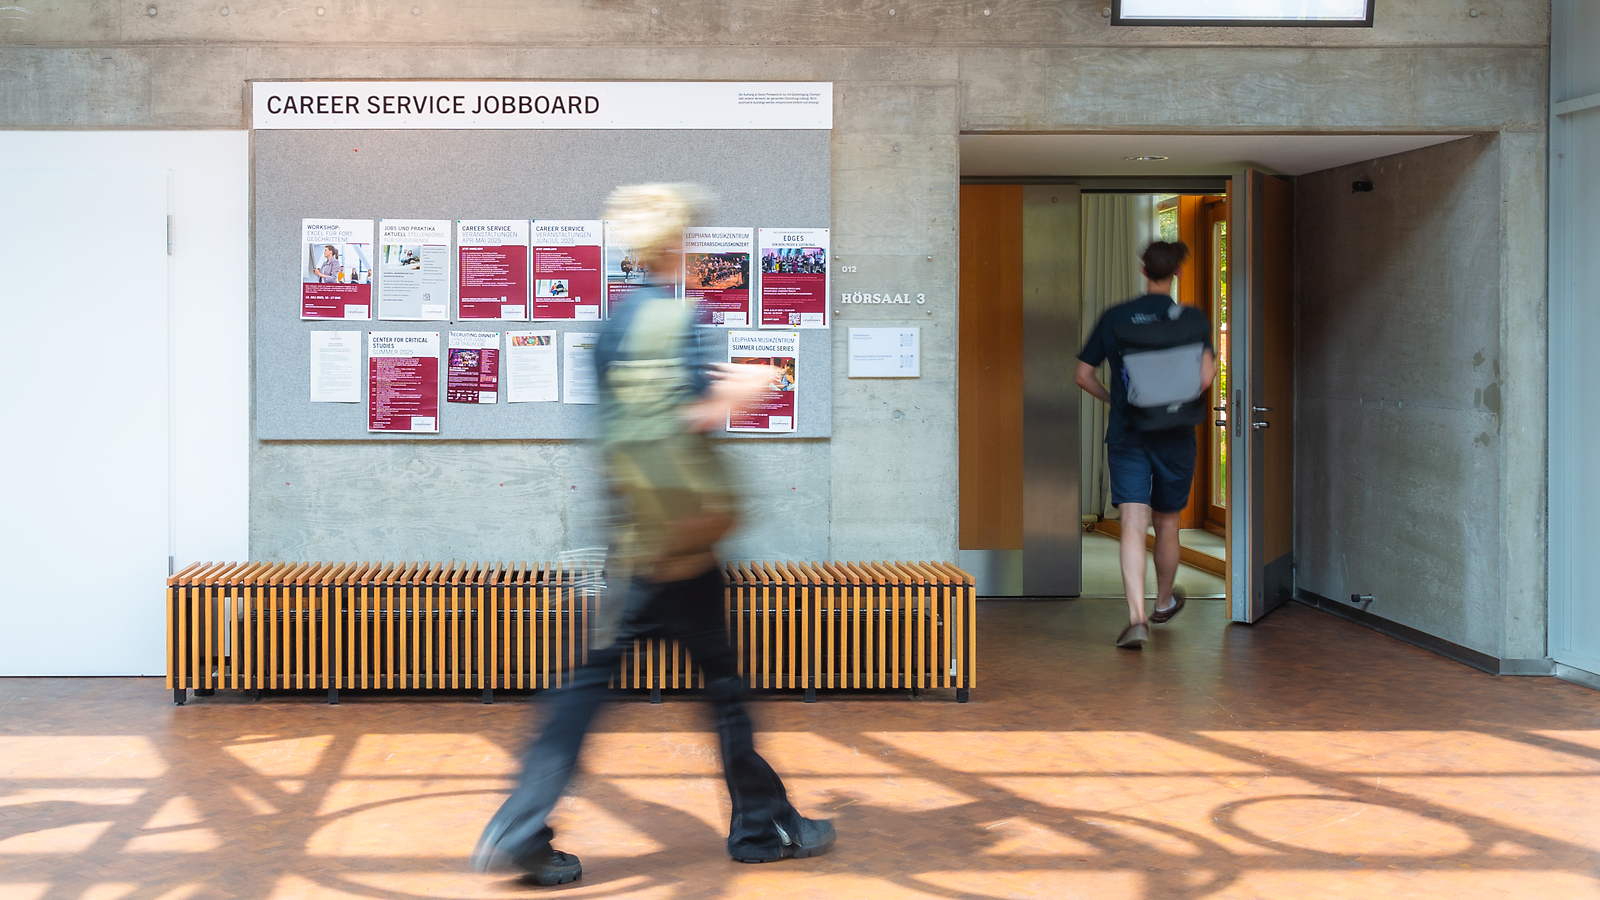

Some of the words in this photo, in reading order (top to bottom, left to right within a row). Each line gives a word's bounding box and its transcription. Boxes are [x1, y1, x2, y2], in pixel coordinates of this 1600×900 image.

[266, 95, 360, 114] CAREER
[367, 95, 466, 114] SERVICE
[472, 95, 600, 114] JOBBOARD
[842, 292, 911, 304] HÖRSAAL
[917, 293, 925, 304] 3
